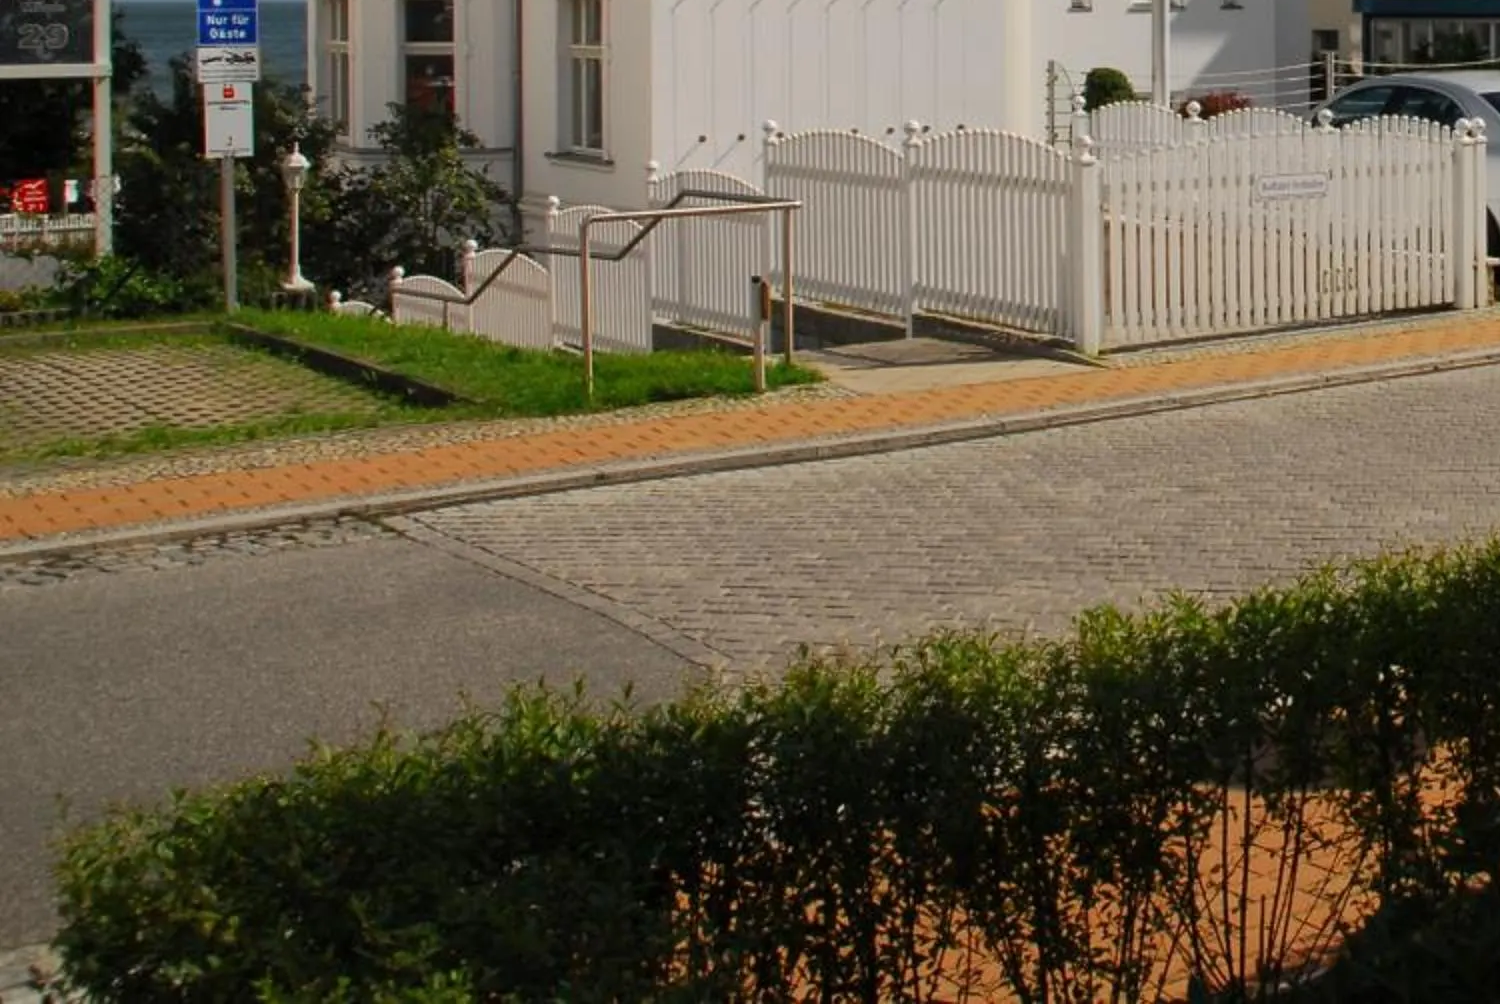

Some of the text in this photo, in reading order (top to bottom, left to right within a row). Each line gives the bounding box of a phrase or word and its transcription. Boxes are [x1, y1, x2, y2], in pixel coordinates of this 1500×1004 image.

[206, 14, 249, 25] Nur für
[17, 23, 70, 50] 29
[209, 27, 247, 39] Gäste
